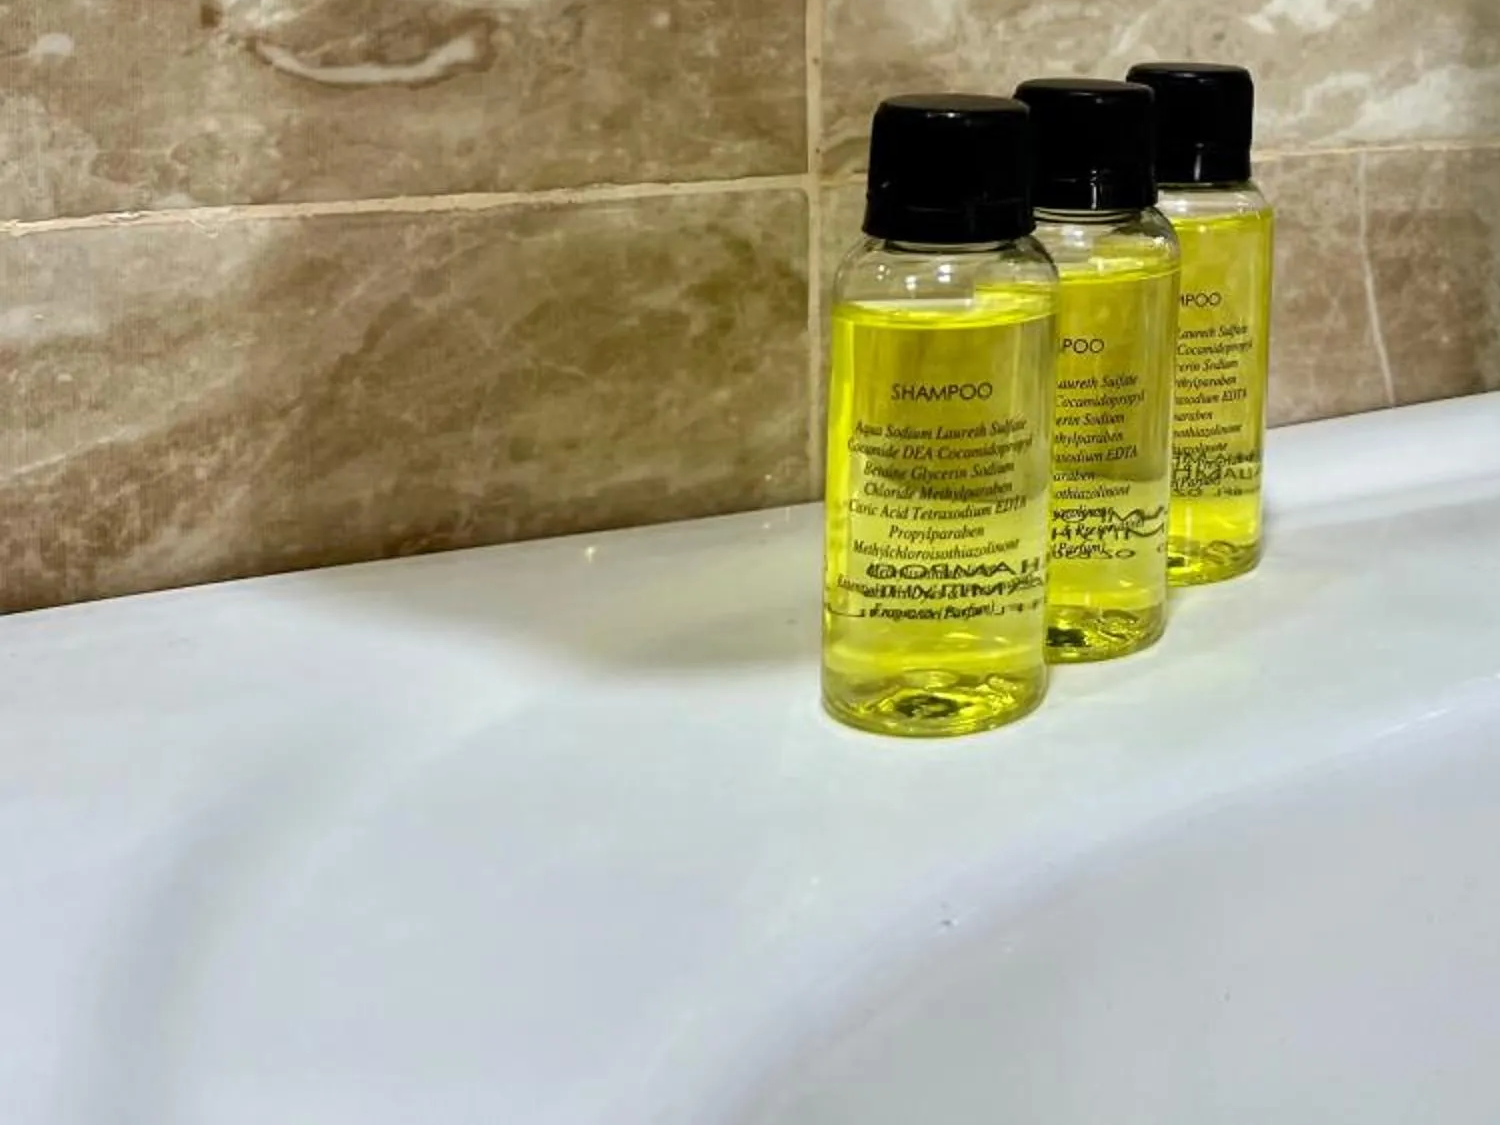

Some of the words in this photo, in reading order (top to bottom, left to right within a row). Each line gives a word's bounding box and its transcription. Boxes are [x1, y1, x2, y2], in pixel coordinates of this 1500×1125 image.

[890, 381, 994, 403] SHAMPOO
[885, 424, 933, 440] Sodium
[935, 422, 987, 441] Laureth
[902, 445, 933, 461] DEA
[1106, 445, 1138, 461] EDTA
[911, 464, 969, 482] Glycerin
[973, 460, 1015, 477] Sodium
[919, 480, 1013, 502] Methylparaben
[880, 504, 909, 519] Acid
[911, 502, 992, 521] Tetrasodium
[994, 495, 1027, 514] EDTA
[888, 524, 985, 543] Propylparaben
